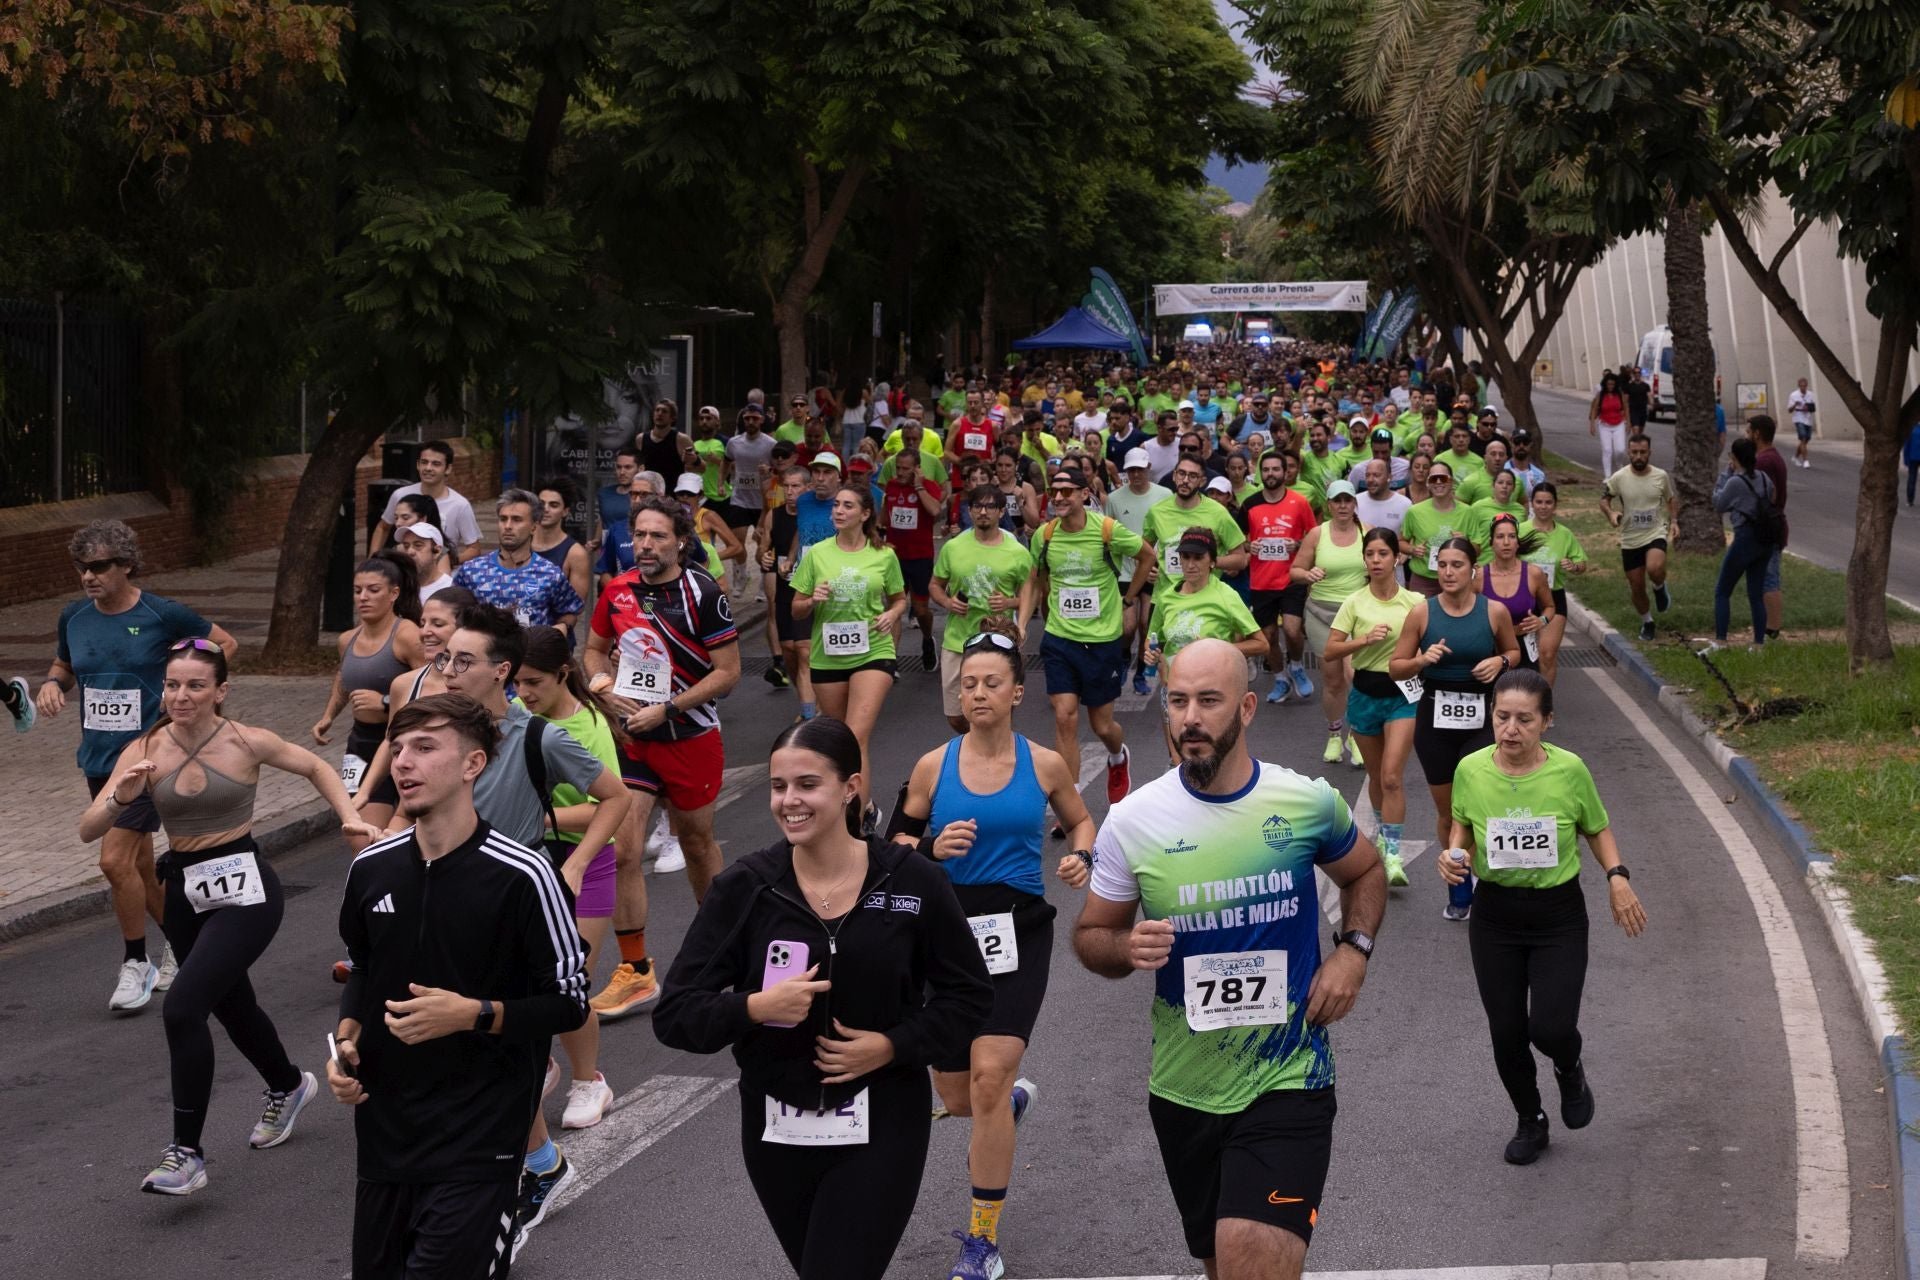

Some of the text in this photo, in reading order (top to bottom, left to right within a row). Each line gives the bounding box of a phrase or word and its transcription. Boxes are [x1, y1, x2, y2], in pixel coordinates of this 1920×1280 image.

[1210, 284, 1315, 294] Carrera de la Prensa
[894, 514, 913, 523] 727
[1262, 545, 1284, 554] 358
[1063, 598, 1093, 609] 482
[828, 632, 861, 645] 803
[630, 671, 656, 689] 28
[89, 702, 132, 716] 1037
[1441, 704, 1477, 718] 889
[1493, 834, 1550, 850] 1122
[1164, 844, 1199, 855] TEAMERGY
[194, 871, 246, 899] 117
[1178, 869, 1294, 907] IV TRIATLÓN
[867, 896, 918, 911] Caln Klein
[1221, 906, 1245, 929] DE
[1248, 896, 1299, 925] MIJAS
[984, 934, 1003, 956] 2
[1196, 976, 1267, 1008] 787
